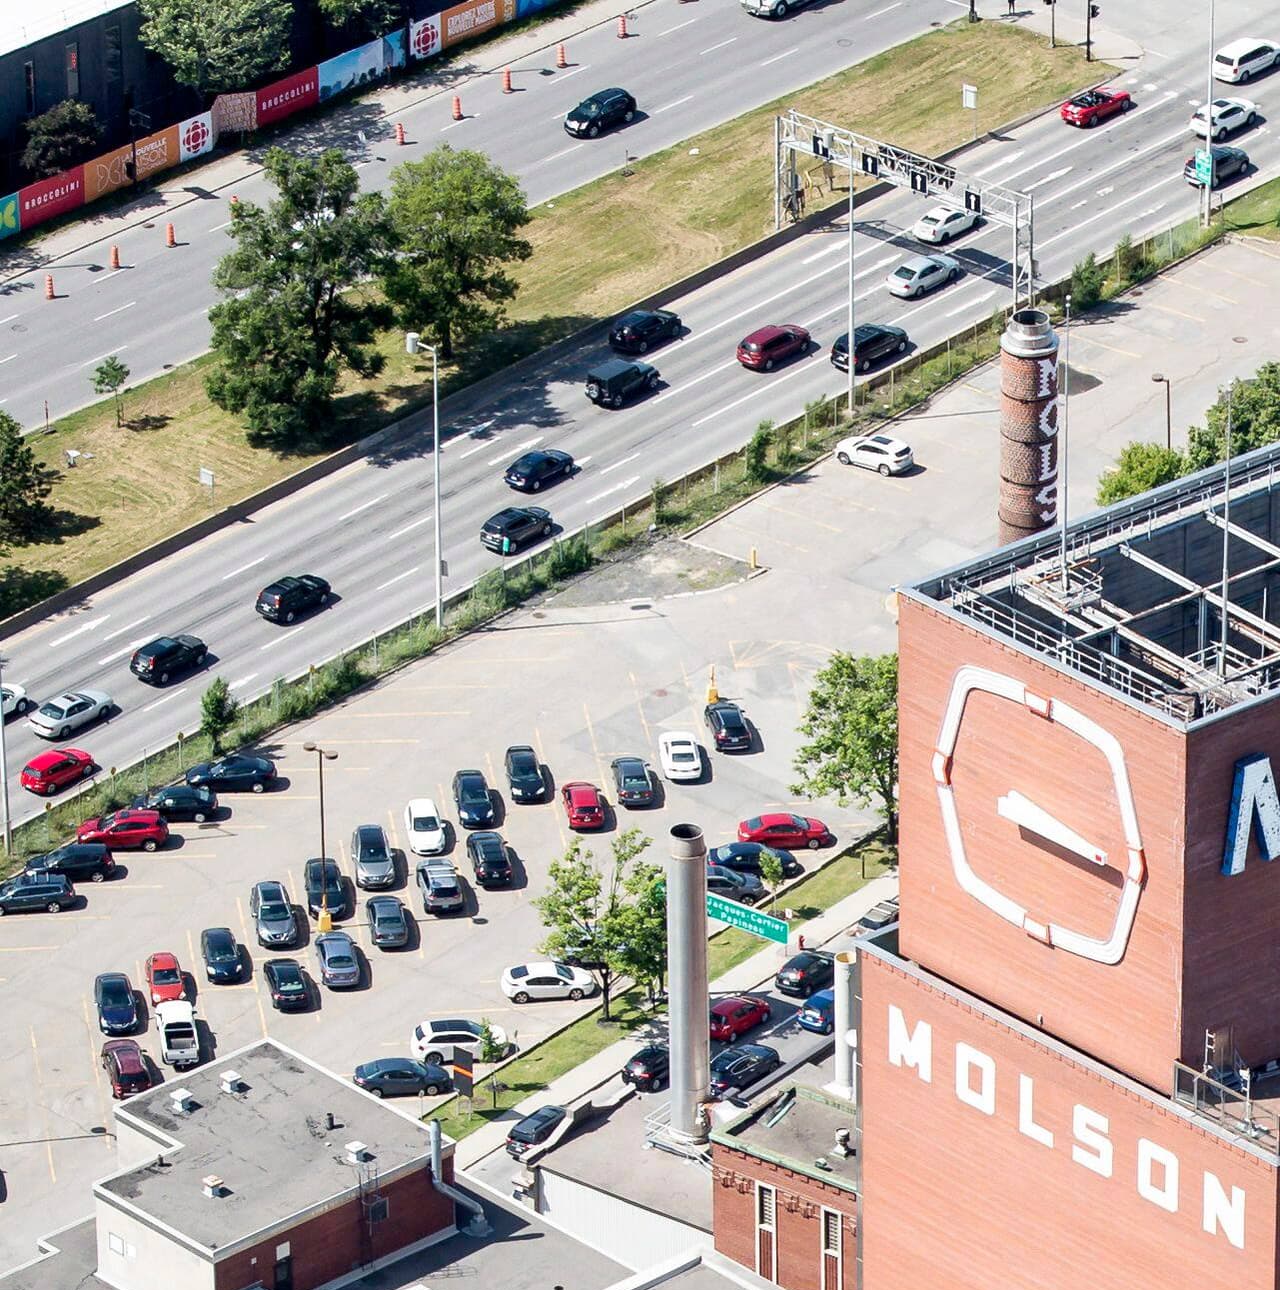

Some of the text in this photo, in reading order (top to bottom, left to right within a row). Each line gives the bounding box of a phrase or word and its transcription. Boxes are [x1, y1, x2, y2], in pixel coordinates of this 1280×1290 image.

[262, 81, 315, 111] BROCCOLINI
[25, 180, 80, 210] BROCCOLINI
[720, 911, 765, 934] Papineau
[888, 1004, 1246, 1250] MOLSON
